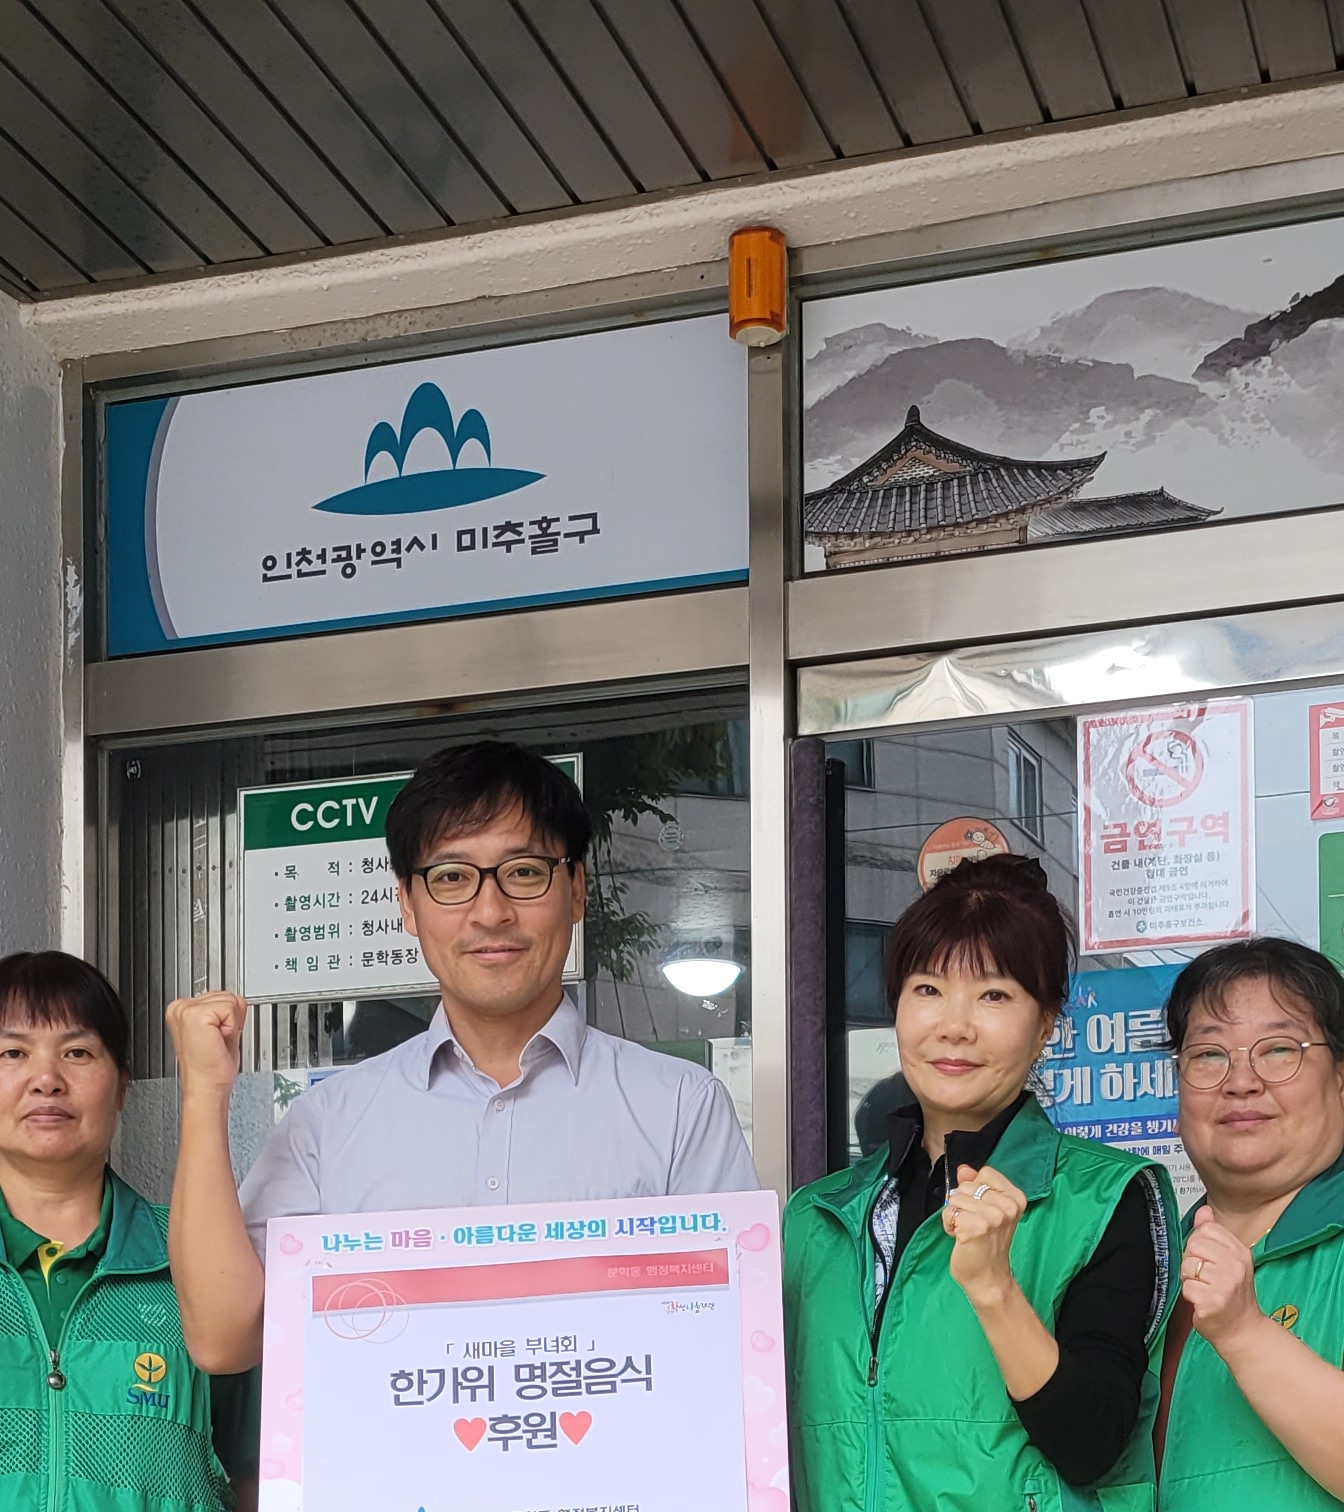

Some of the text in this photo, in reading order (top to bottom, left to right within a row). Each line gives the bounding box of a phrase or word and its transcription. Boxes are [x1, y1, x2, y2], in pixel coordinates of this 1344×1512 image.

[261, 511, 601, 583] 인천광역시 미추홀구
[290, 796, 378, 831] CCTV
[1100, 812, 1231, 855] 금연구역
[361, 855, 393, 875] 청사
[1168, 866, 1189, 877] 금연
[284, 892, 340, 912] 촬영시간
[284, 922, 340, 943] 촬영범위
[361, 947, 418, 968] 문학동장
[1086, 1009, 1172, 1054] 여름
[1099, 1060, 1179, 1101] 하세
[1105, 1121, 1143, 1137] 건강을
[1153, 1144, 1171, 1155] 매일
[321, 1212, 730, 1253] 나누는 마음 아름다운 세상의 시작입니다.
[607, 1262, 715, 1278] 문학동 행정복지센터
[463, 1334, 578, 1360] 새마을 부녀회
[389, 1353, 653, 1408] 한가위 명절음식
[126, 1387, 170, 1409] SMU
[486, 1410, 558, 1452] 후원
